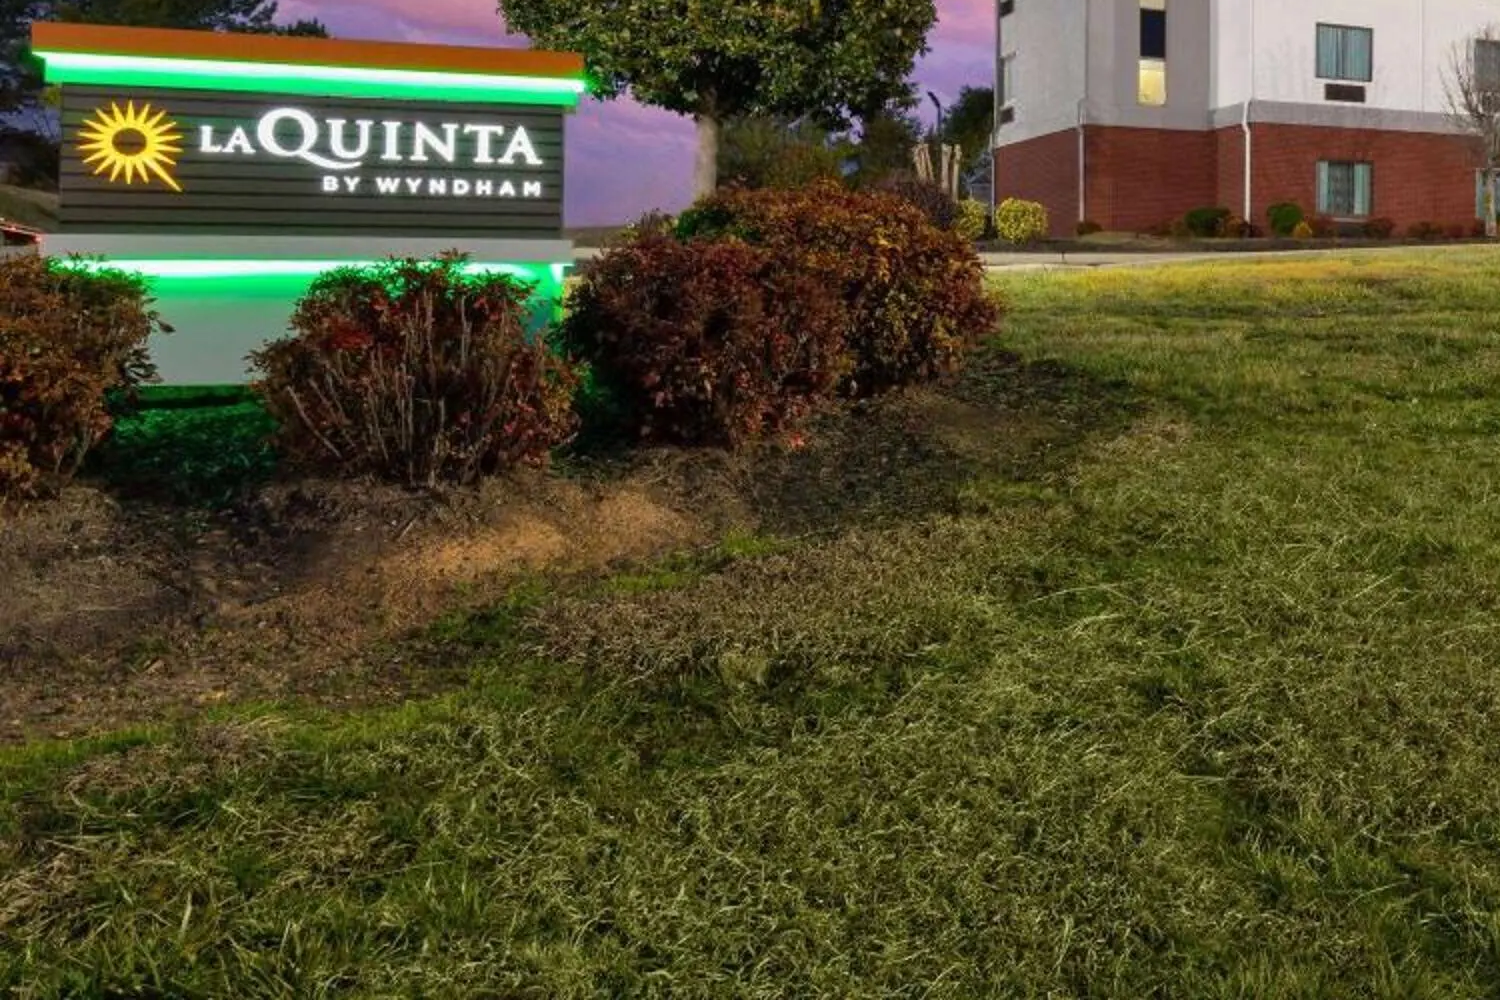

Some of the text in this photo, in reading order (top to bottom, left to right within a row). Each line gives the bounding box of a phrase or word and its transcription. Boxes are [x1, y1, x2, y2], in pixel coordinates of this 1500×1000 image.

[199, 107, 542, 169] LA QUINTA
[322, 175, 542, 197] BY WYNDHAM
